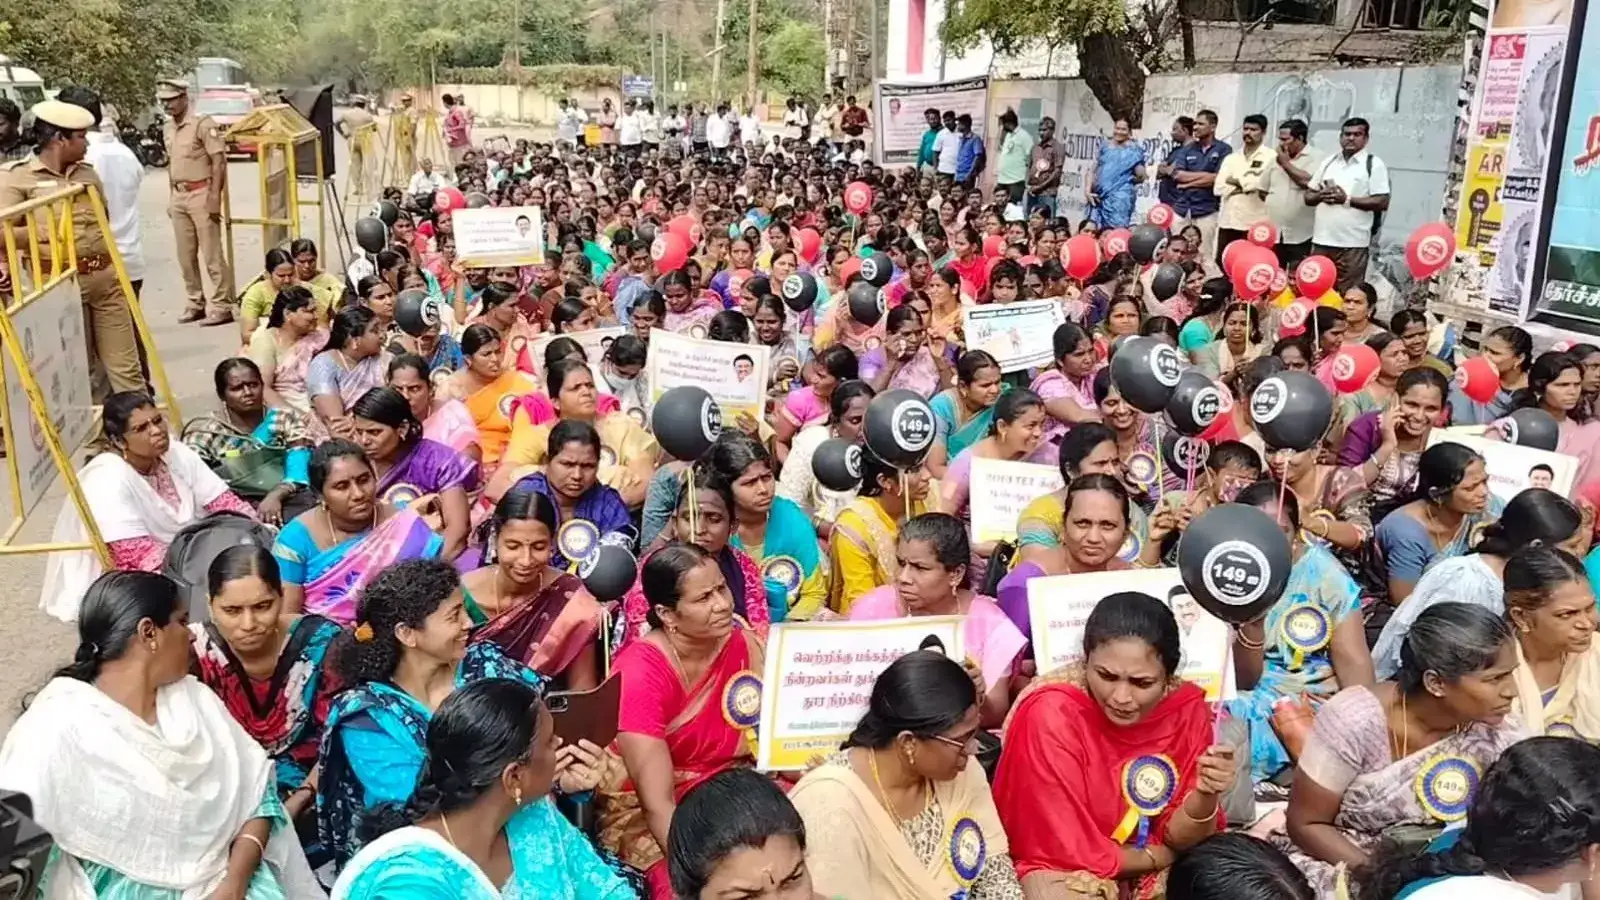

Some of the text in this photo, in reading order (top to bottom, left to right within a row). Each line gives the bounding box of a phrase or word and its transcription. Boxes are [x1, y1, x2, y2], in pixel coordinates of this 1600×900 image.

[900, 418, 923, 432] 149
[1213, 563, 1247, 583] 149
[792, 648, 853, 665] வெற்றிக்கு
[783, 670, 853, 687] நின்றவர்கள்
[1138, 773, 1155, 788] 149
[1437, 780, 1457, 791] 149
